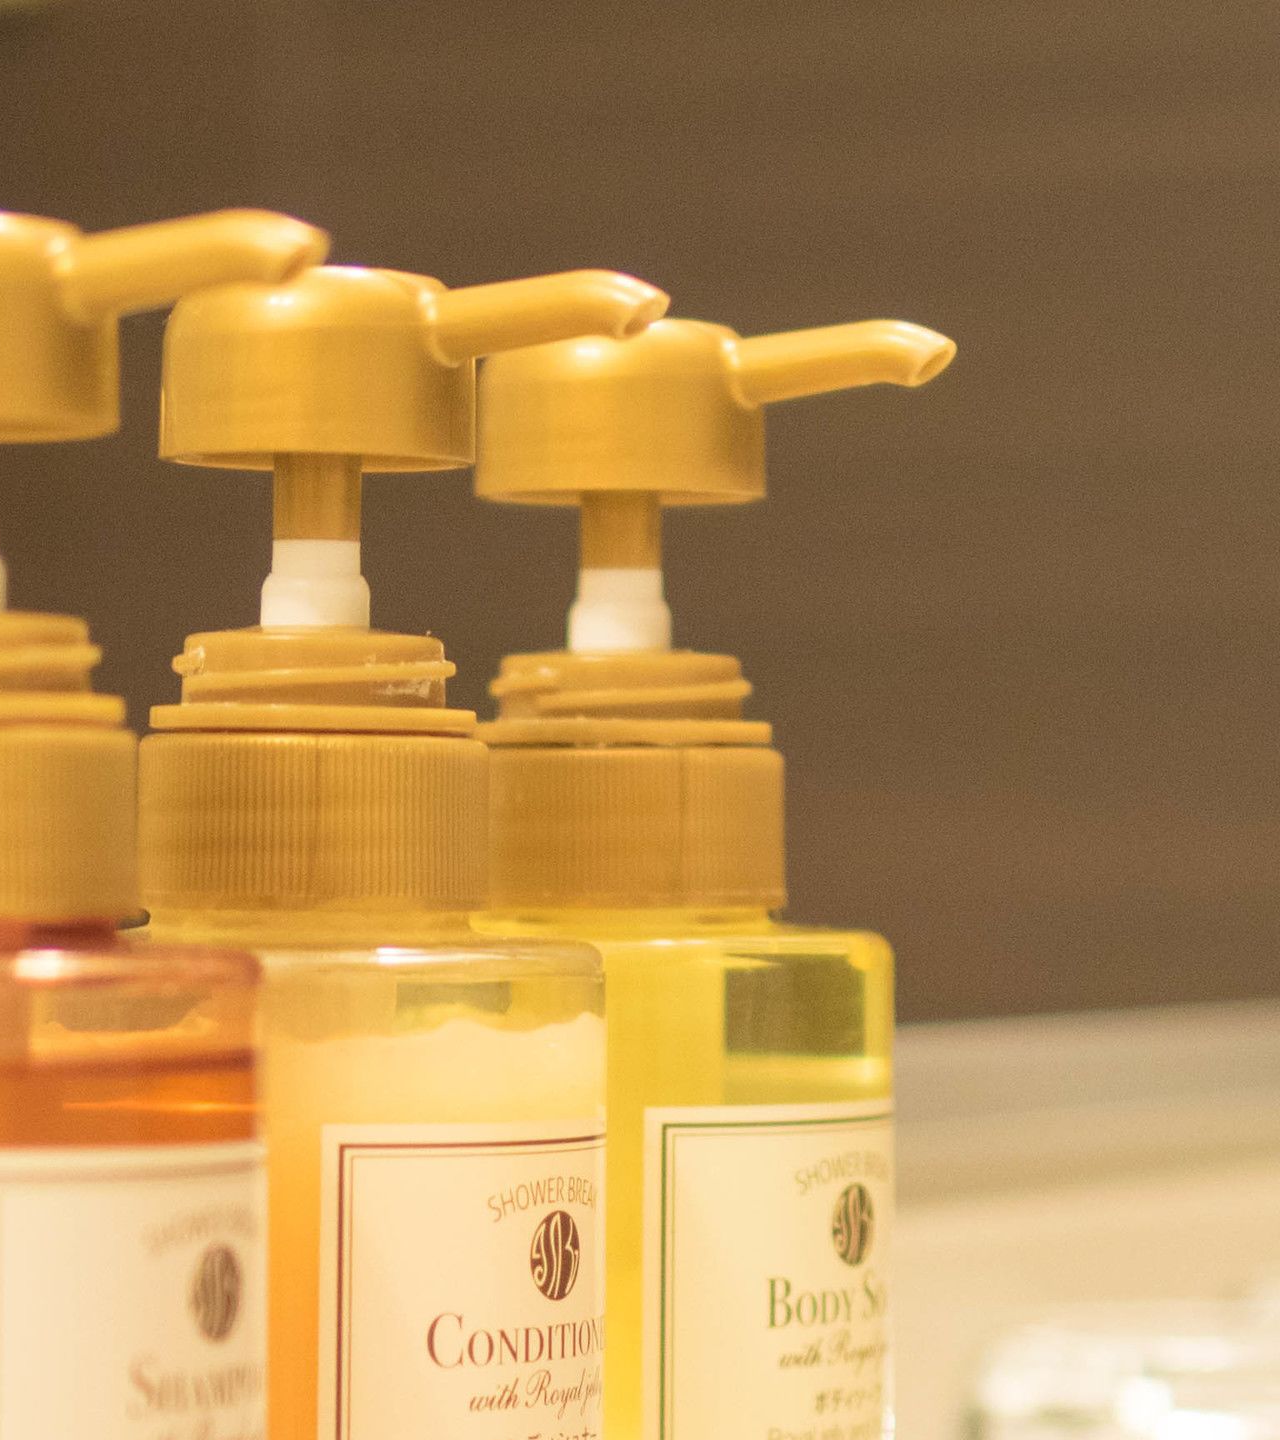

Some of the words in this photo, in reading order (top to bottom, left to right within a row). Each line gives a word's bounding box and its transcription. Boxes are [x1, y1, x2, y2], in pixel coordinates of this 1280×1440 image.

[487, 1175, 565, 1223] SHOWER
[766, 1277, 853, 1329] BODY
[468, 1376, 520, 1412] with
[524, 1368, 585, 1421] Royal
